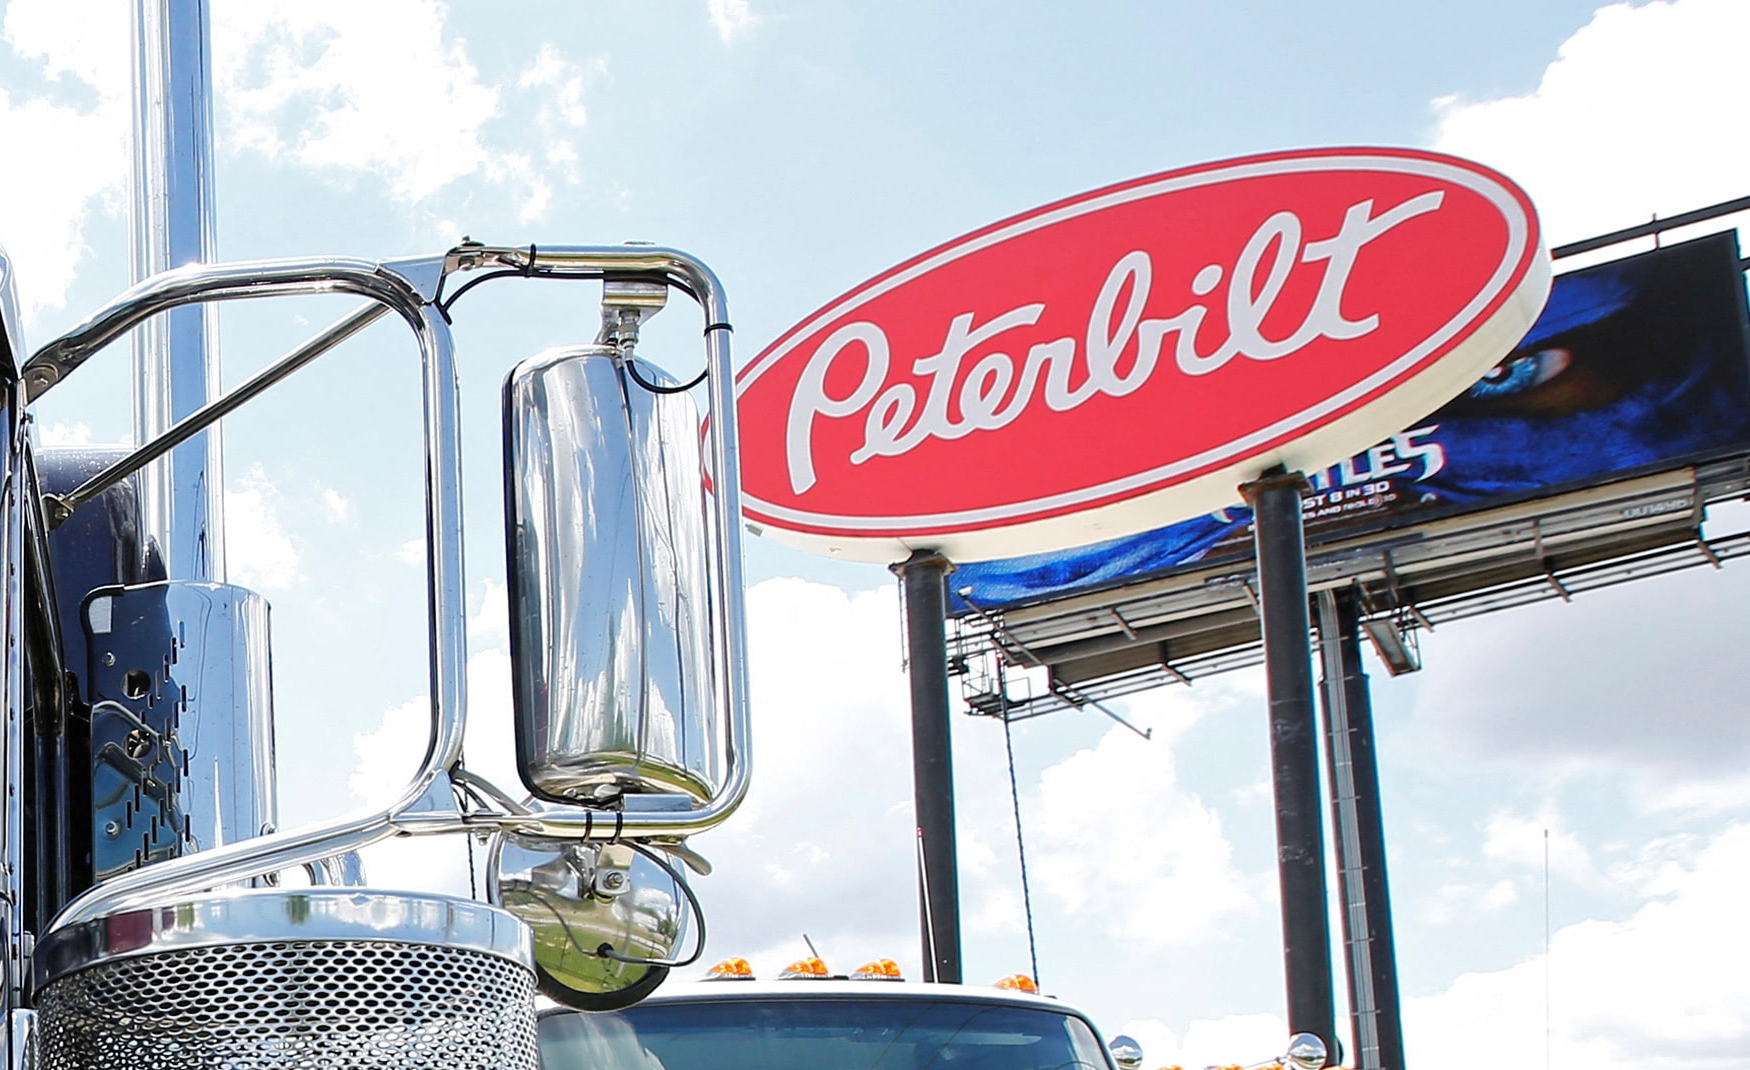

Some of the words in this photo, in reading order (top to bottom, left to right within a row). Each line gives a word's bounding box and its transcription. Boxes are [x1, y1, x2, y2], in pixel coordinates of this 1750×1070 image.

[787, 190, 1445, 496] Peterbilt
[1329, 491, 1344, 504] 8
[1345, 487, 1361, 499] IN
[1362, 480, 1391, 496] 3D
[1317, 505, 1342, 517] AND
